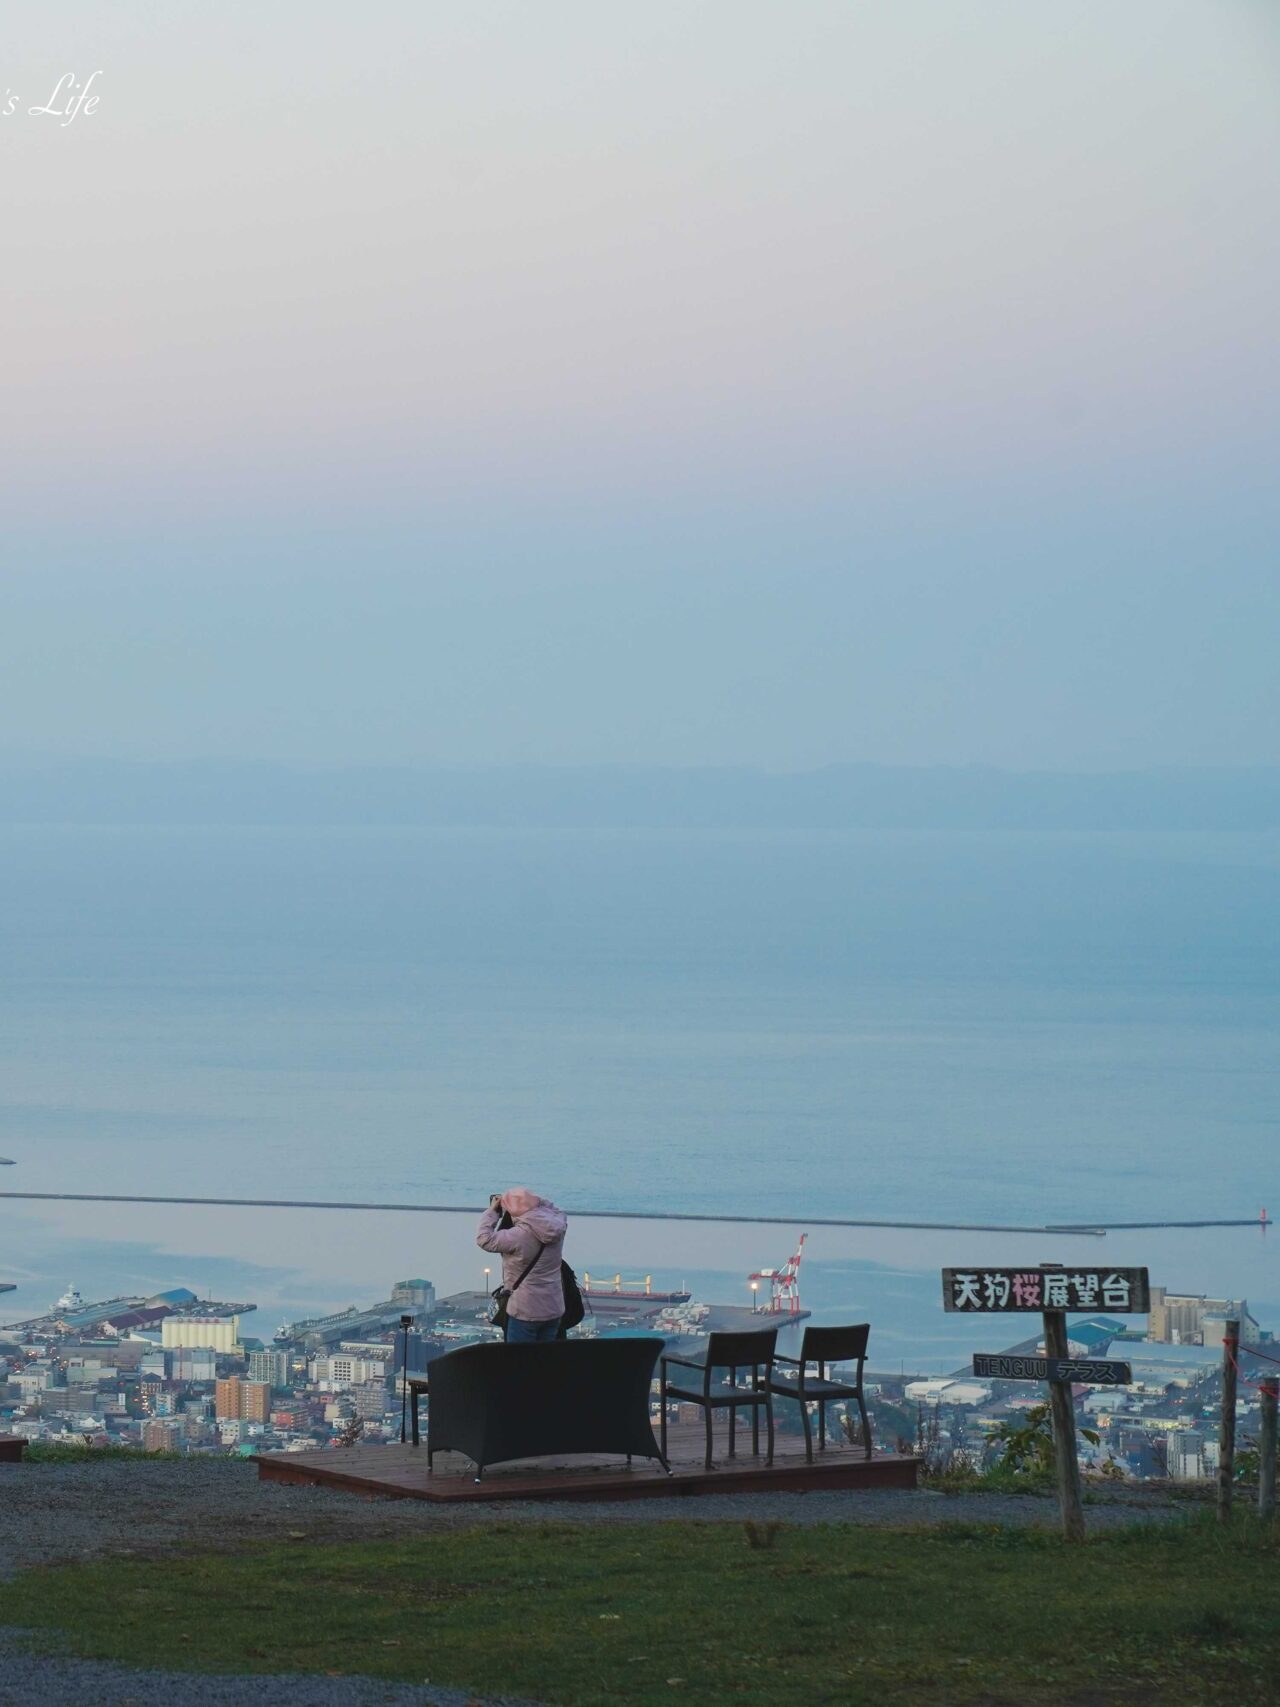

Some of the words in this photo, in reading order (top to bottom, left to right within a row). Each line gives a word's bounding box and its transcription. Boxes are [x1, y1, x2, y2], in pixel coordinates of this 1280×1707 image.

[954, 1273, 1130, 1308] 天狗桜展望台
[976, 1357, 1048, 1378] TENGUU
[1058, 1361, 1118, 1380] テラス
